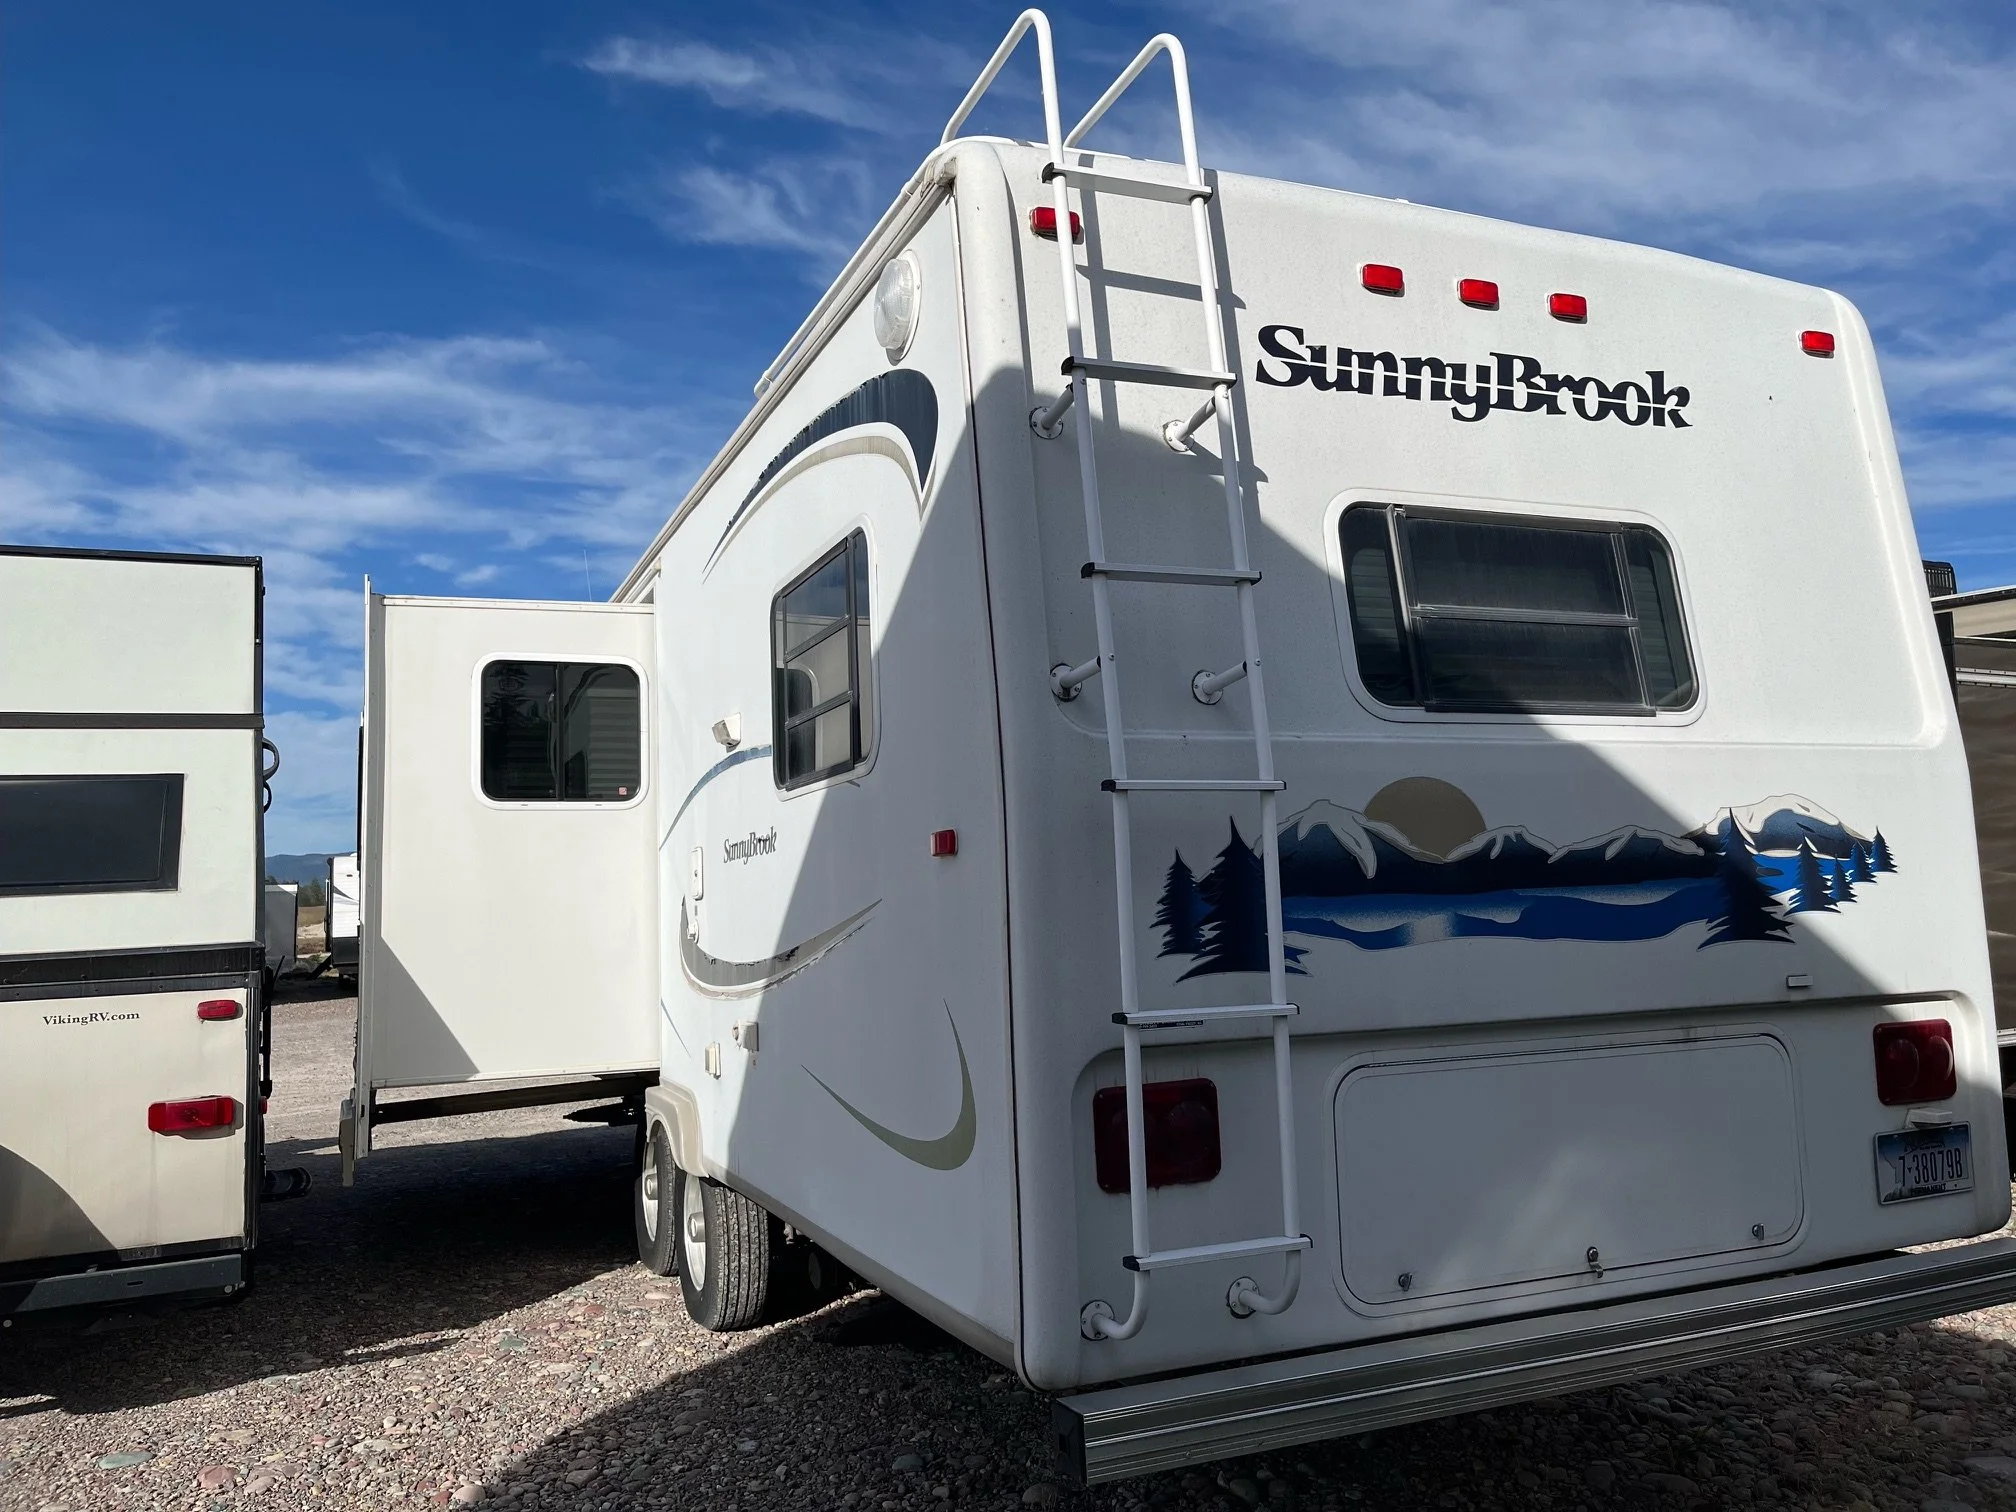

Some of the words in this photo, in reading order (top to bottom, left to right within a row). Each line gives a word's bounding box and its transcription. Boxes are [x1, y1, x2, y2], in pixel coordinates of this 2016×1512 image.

[1256, 324, 1693, 428] SunnyBrook
[723, 825, 777, 865] SunnyBrook
[42, 1011, 140, 1026] VikingRV.com
